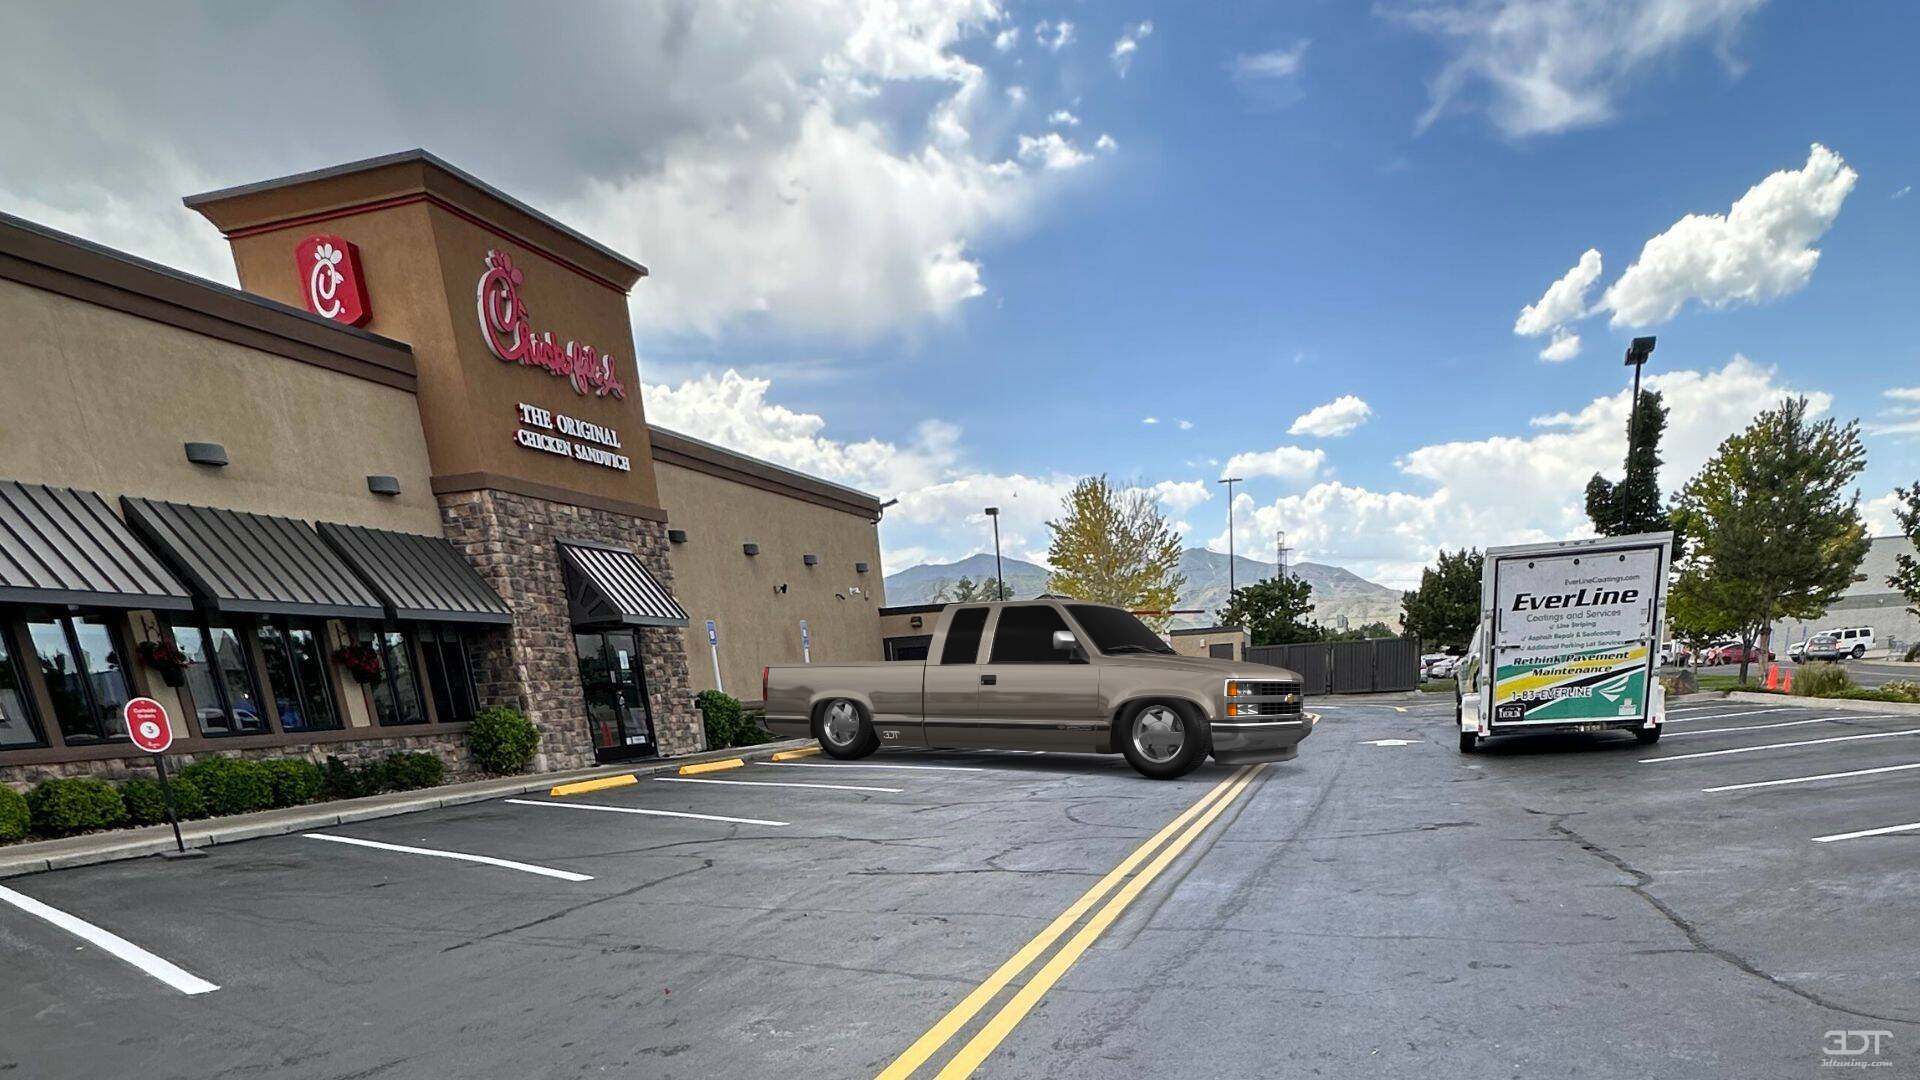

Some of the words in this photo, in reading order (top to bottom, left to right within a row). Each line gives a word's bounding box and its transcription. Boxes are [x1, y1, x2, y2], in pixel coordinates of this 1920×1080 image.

[519, 402, 553, 430] THE
[556, 414, 621, 448] ORIGINAL
[517, 429, 574, 457] CHICKEN
[574, 444, 631, 471] SANDWICH
[1564, 574, 1640, 586] EverLineCoatings.com
[1512, 587, 1639, 612] EverLine
[1526, 613, 1563, 623] Coatings
[1566, 610, 1583, 620] and
[1586, 608, 1621, 619] Services
[1571, 620, 1597, 629] Striping
[1528, 633, 1552, 643] Asphalt
[1554, 631, 1574, 640] Repair
[1582, 629, 1621, 639] Sealcoating
[1526, 641, 1559, 651] Additional
[1560, 641, 1585, 649] Parking
[1598, 638, 1625, 647] Services
[1513, 654, 1561, 666] Rethink
[1565, 651, 1629, 662] Pavement
[1532, 665, 1612, 677] Maintenance
[1511, 686, 1593, 701] 1-83-EVERLINE
[146, 726, 154, 734] 3
